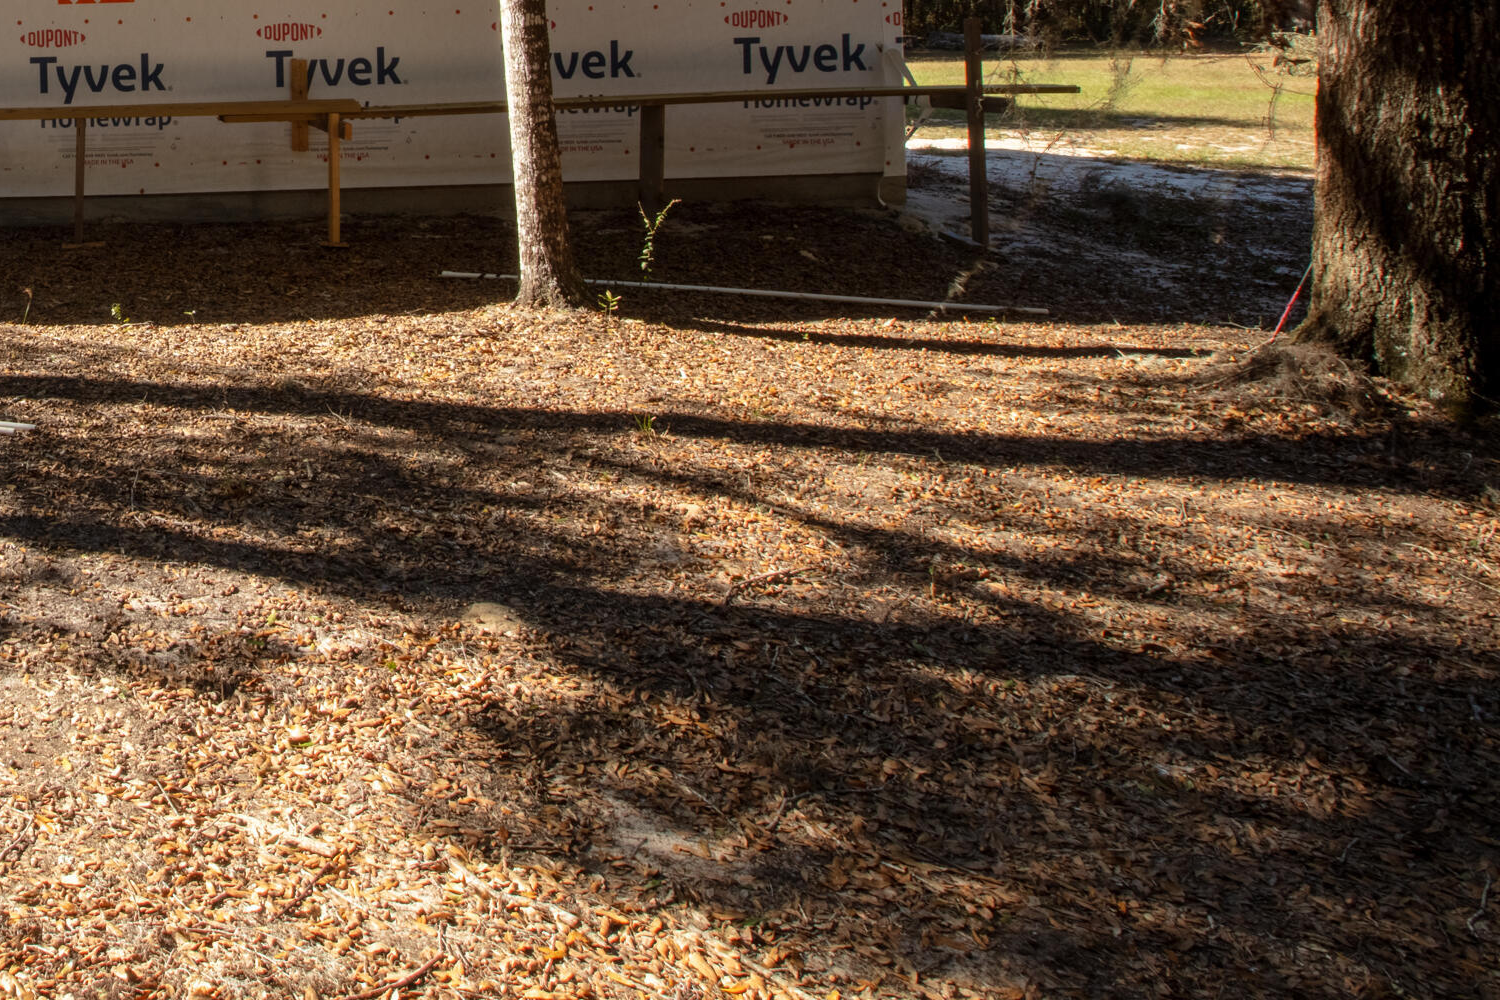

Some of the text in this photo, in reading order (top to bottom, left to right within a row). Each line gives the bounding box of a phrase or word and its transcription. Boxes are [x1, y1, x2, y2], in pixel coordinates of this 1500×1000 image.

[264, 23, 315, 41] DUPONT
[732, 10, 781, 28] DUPONT
[28, 29, 79, 48] DUPONT
[549, 40, 636, 80] vek
[733, 33, 867, 85] Tyvek
[30, 53, 166, 104] Tyvek
